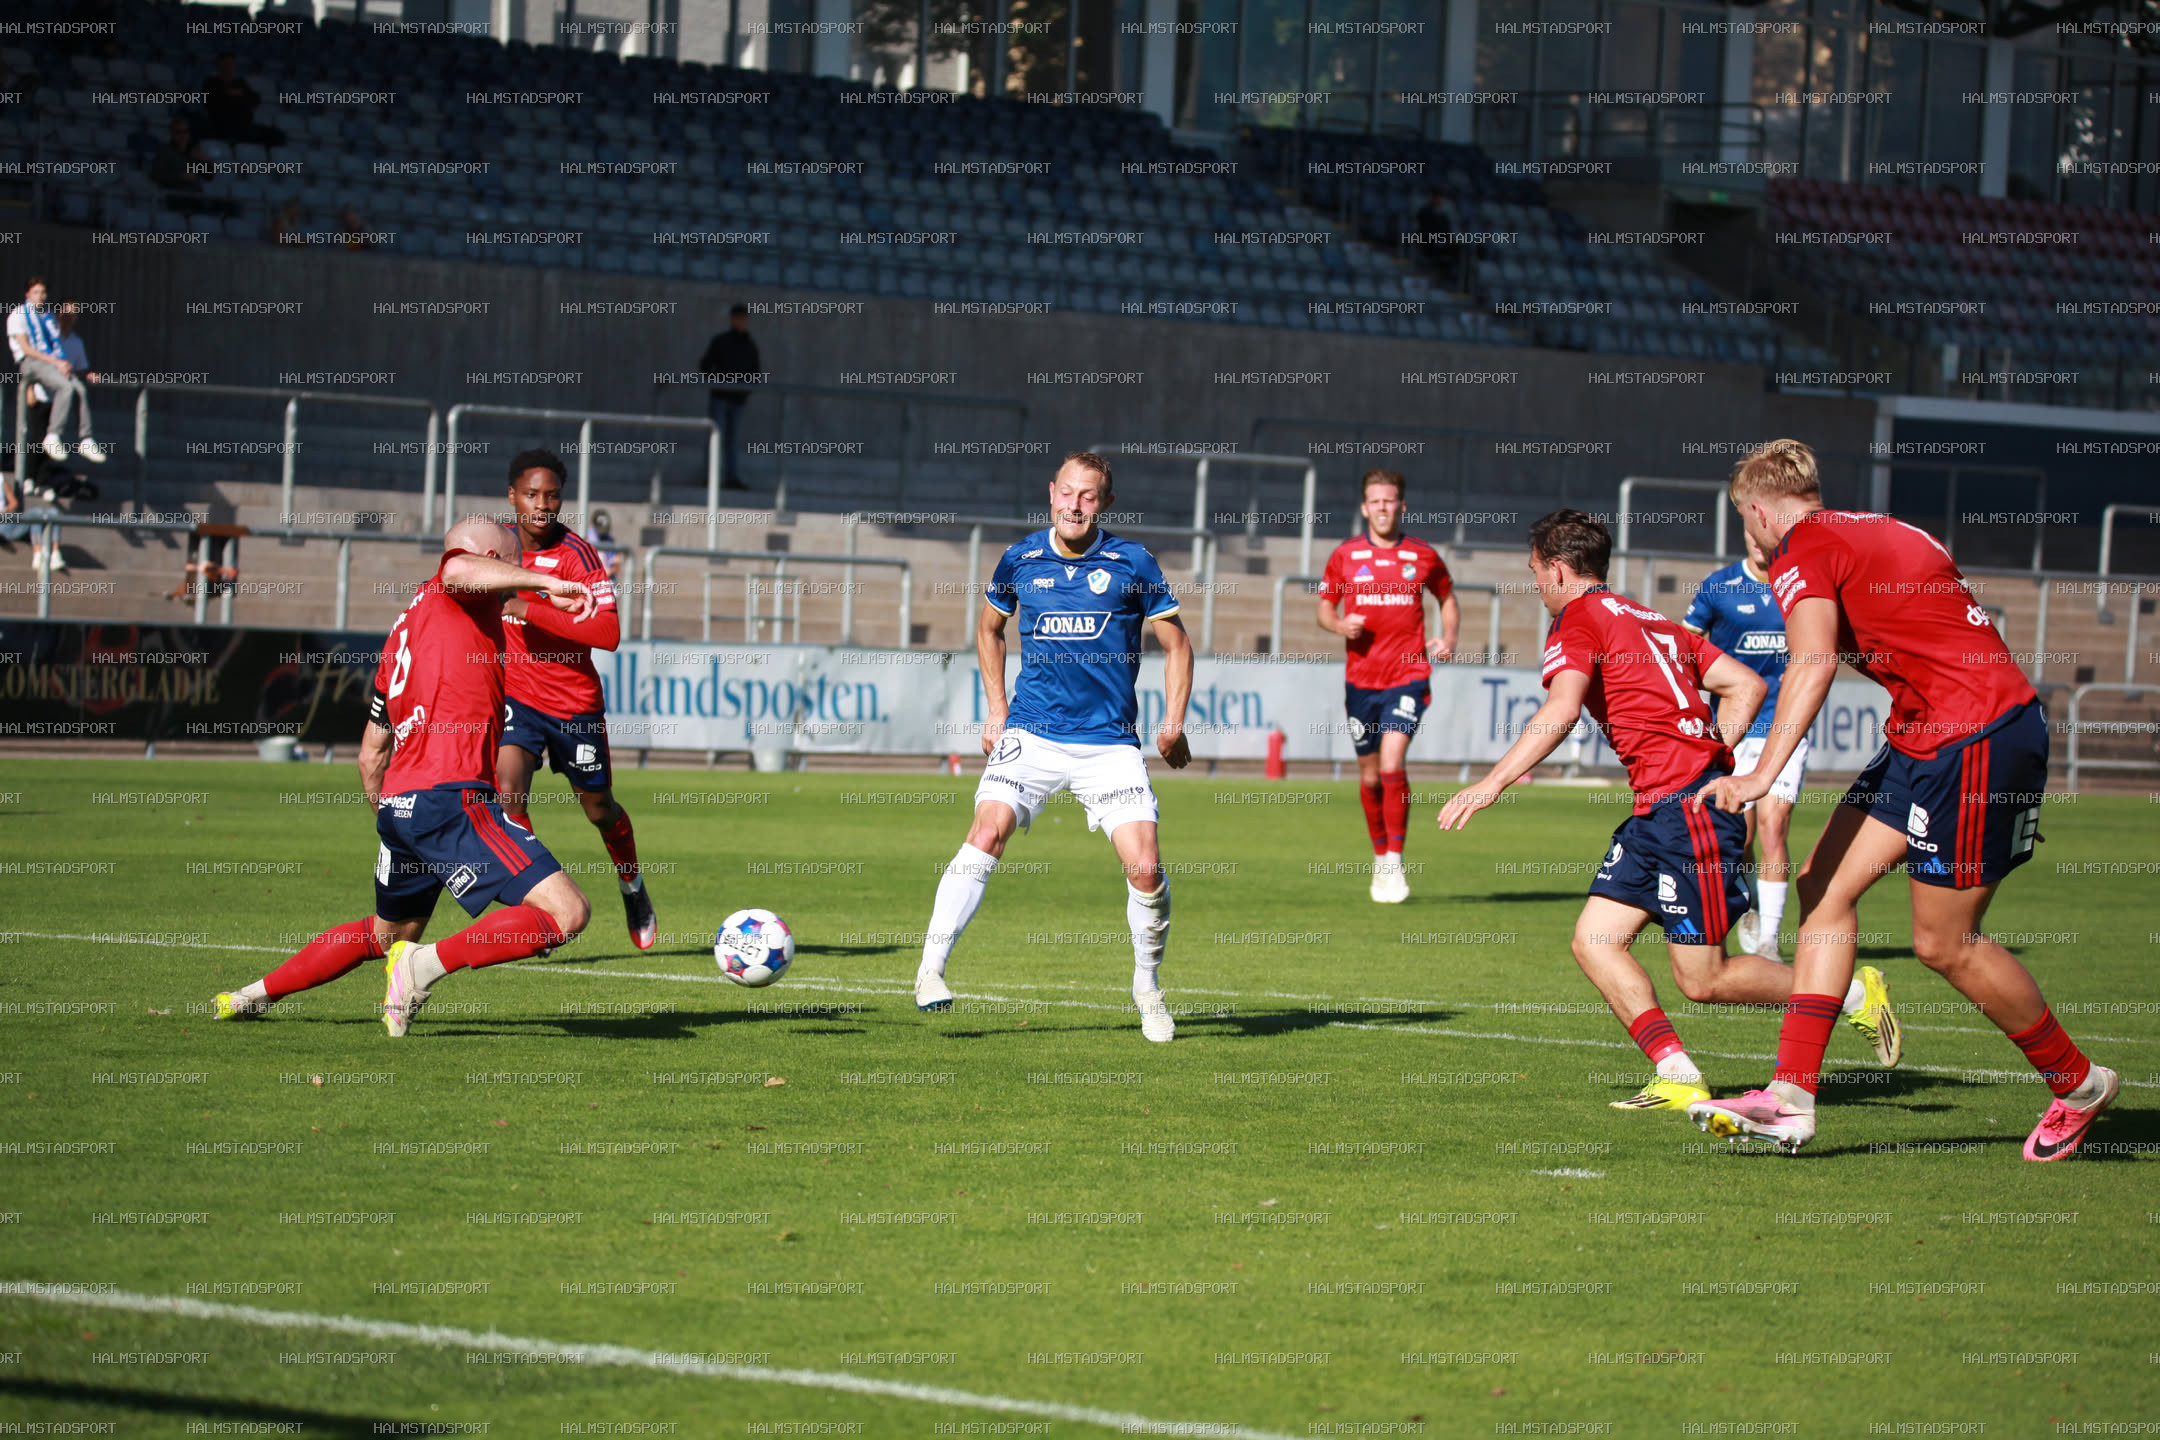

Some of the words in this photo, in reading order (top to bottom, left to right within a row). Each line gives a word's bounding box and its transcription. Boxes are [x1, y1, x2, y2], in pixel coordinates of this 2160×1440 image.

[1355, 594, 1415, 606] EMILSHUS
[1041, 616, 1096, 635] JONAB
[1743, 635, 1786, 650] JONAB
